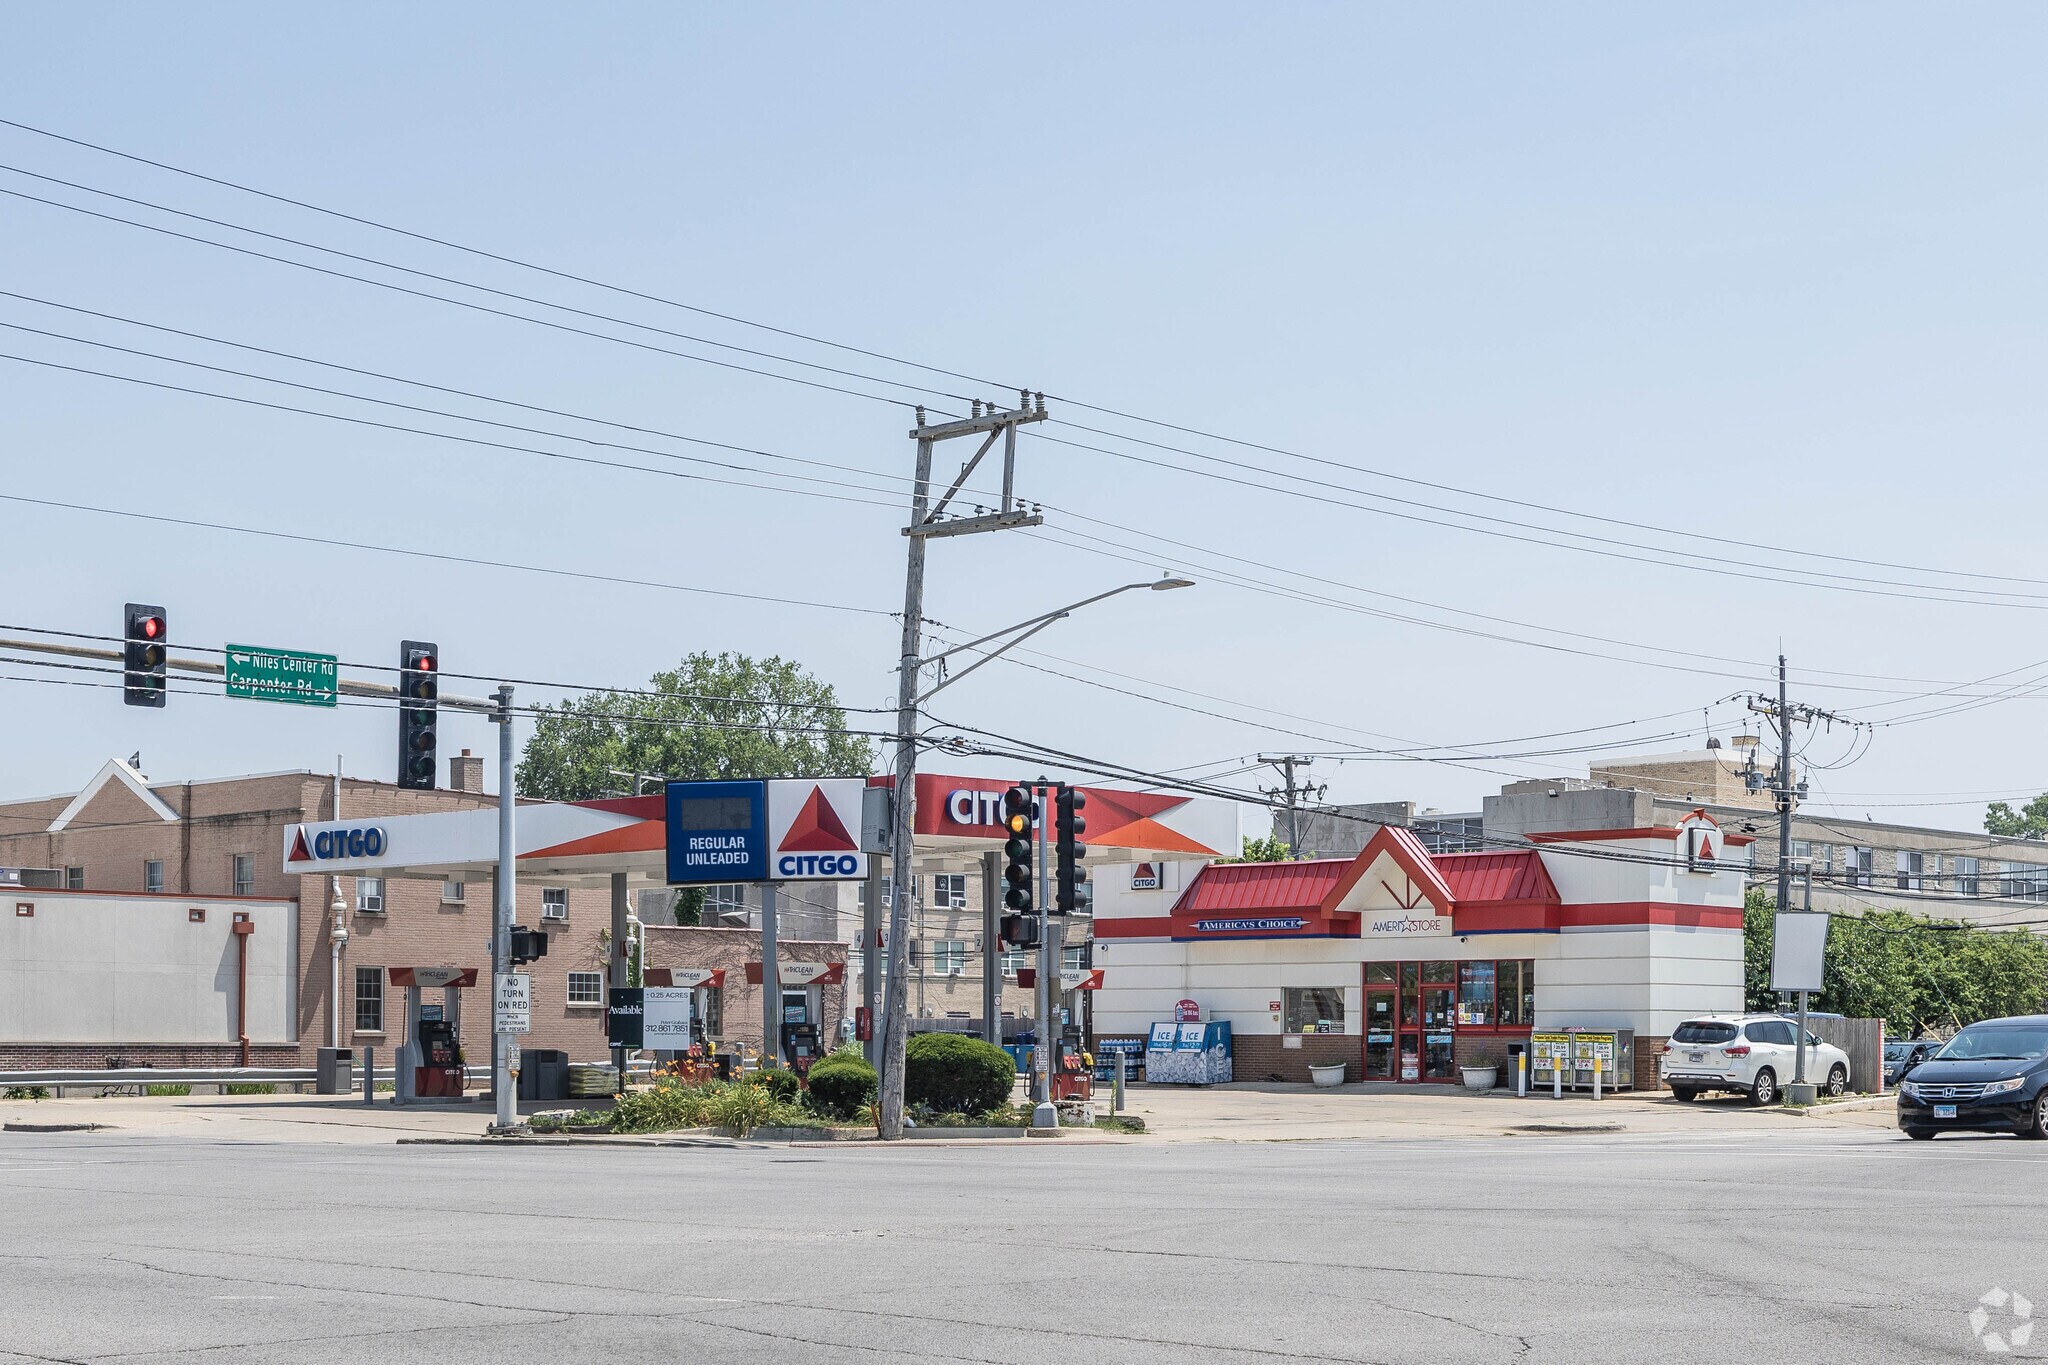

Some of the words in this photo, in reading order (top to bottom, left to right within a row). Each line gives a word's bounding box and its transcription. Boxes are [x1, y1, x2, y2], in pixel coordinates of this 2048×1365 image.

[252, 651, 279, 670] Niles
[282, 654, 318, 673] Center
[321, 658, 334, 676] Rd
[230, 672, 293, 695] Carpenter
[297, 679, 312, 696] Rd
[314, 827, 386, 860] CITGO
[689, 836, 745, 850] REGULAR
[686, 852, 749, 866] UNLEADED
[778, 855, 858, 876] CITGO
[1133, 878, 1156, 888] CITGO
[1258, 919, 1297, 929] CHOICE
[507, 978, 519, 987] NO
[502, 989, 524, 998] TURN
[497, 1001, 509, 1009] ON
[512, 1001, 528, 1009] RED
[608, 1005, 643, 1015] Available
[645, 1024, 657, 1032] 312
[658, 1024, 671, 1032] 861
[671, 1024, 688, 1032] 7851
[1157, 1031, 1171, 1040] ICE
[1185, 1032, 1199, 1041] ICE
